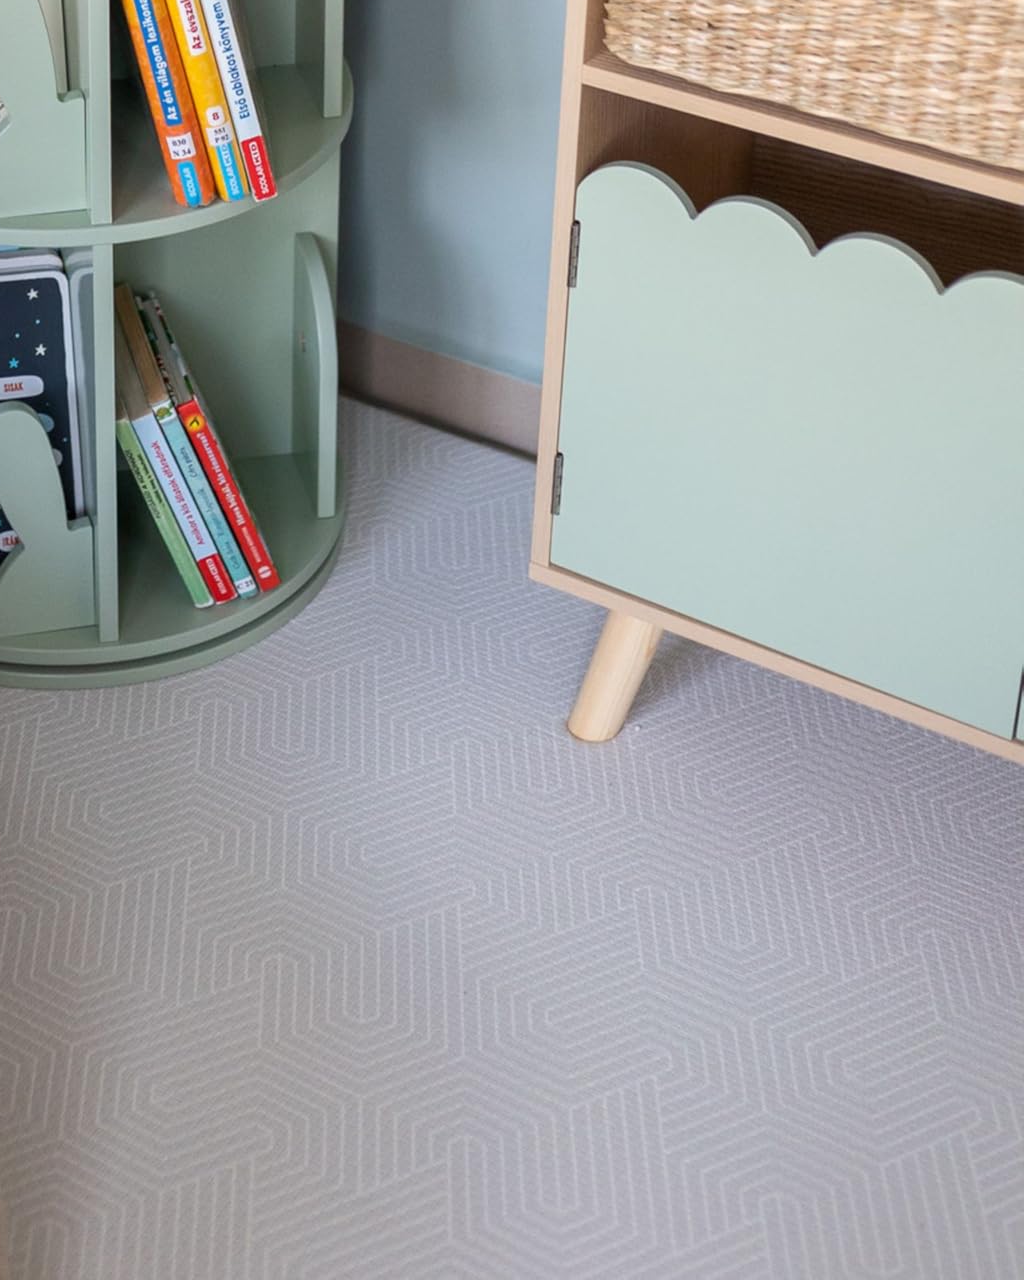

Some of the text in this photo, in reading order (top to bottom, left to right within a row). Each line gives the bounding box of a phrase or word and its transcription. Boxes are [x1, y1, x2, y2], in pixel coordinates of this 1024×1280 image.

[192, 36, 203, 49] Az
[151, 44, 169, 88] világom
[213, 1, 250, 120] Első ablakos könyvem
[163, 89, 174, 103] én
[167, 105, 178, 120] Az
[183, 167, 197, 197] SCOLAR
[226, 166, 240, 195] SCOLAR
[249, 142, 269, 194] SCOLAR KID
[3, 382, 23, 393] SISAK
